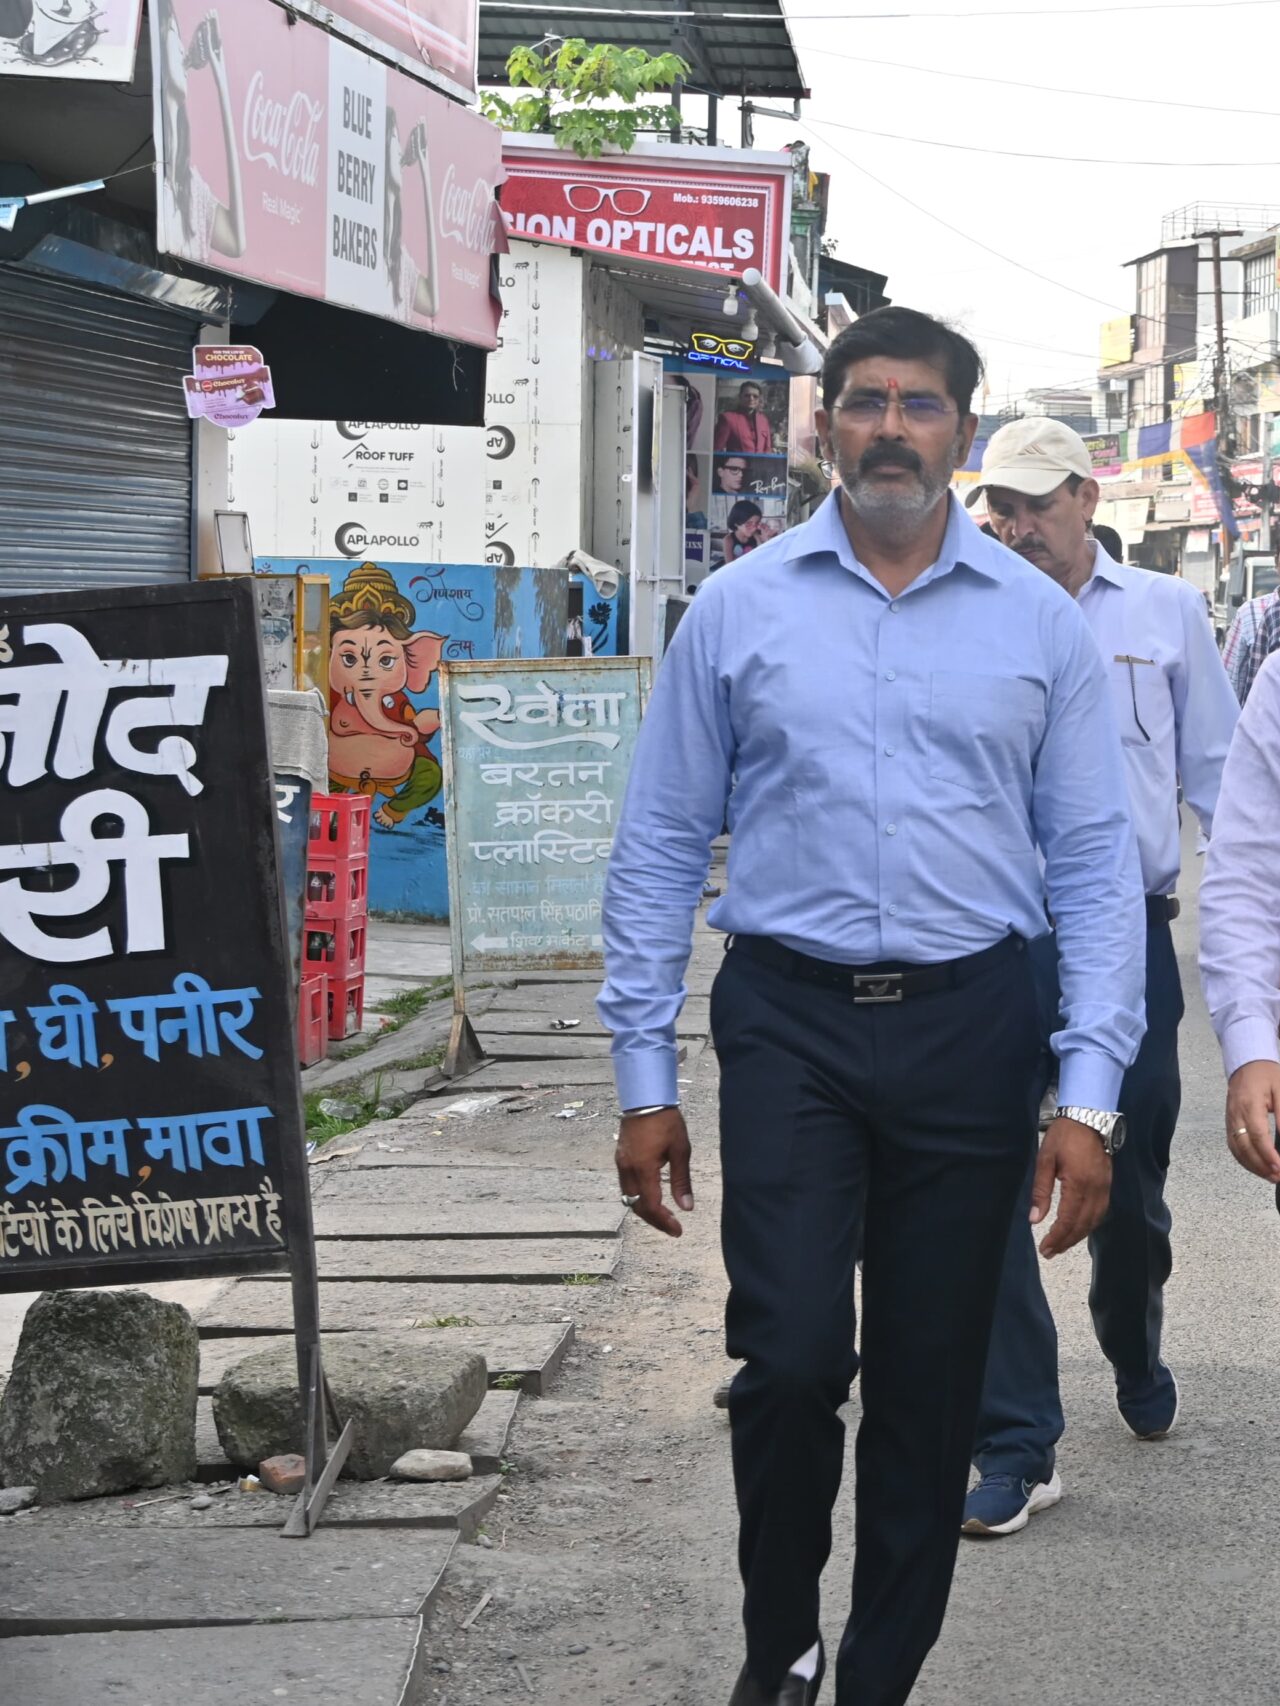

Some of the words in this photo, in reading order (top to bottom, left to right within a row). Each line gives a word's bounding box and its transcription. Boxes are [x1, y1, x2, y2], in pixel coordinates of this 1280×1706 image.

[343, 86, 373, 140] BLUE
[337, 150, 376, 205] BERRY
[332, 214, 378, 271] BAKERS
[586, 218, 755, 259] OPTICALS
[687, 350, 751, 370] OPTICAL
[355, 450, 386, 461] ROOF
[388, 451, 415, 462] TUFF
[479, 762, 613, 787] बरतन
[494, 790, 615, 827] क्रॉकरी
[487, 905, 536, 923] सतपाल
[540, 898, 564, 925] सिंह
[105, 971, 264, 1063] पनीर
[51, 1197, 83, 1253] के
[82, 1194, 136, 1254] लिये
[131, 1190, 200, 1249] विशेष
[196, 1193, 263, 1245] प्रबन्ध
[259, 1176, 287, 1247] है
